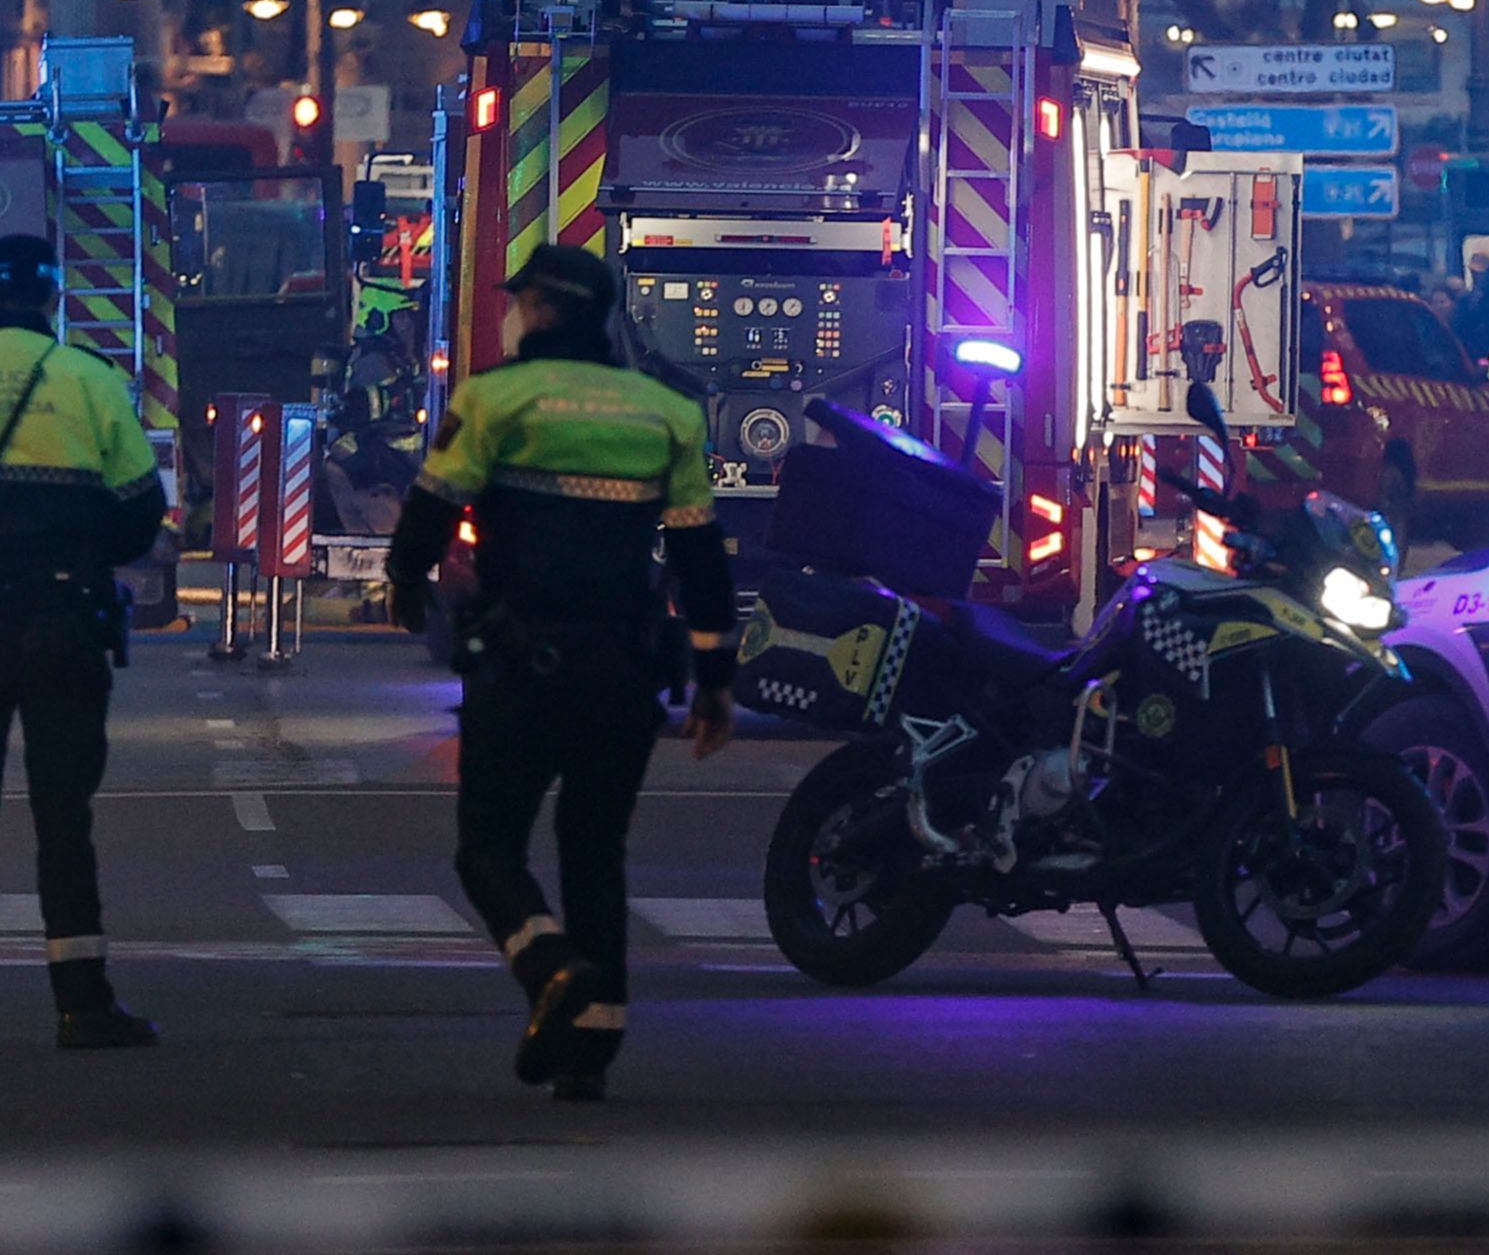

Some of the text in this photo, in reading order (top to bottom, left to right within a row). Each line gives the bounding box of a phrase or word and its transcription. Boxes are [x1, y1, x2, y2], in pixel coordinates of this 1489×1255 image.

[1263, 47, 1390, 63] centre ciutat
[1257, 69, 1391, 86] centro ciudad
